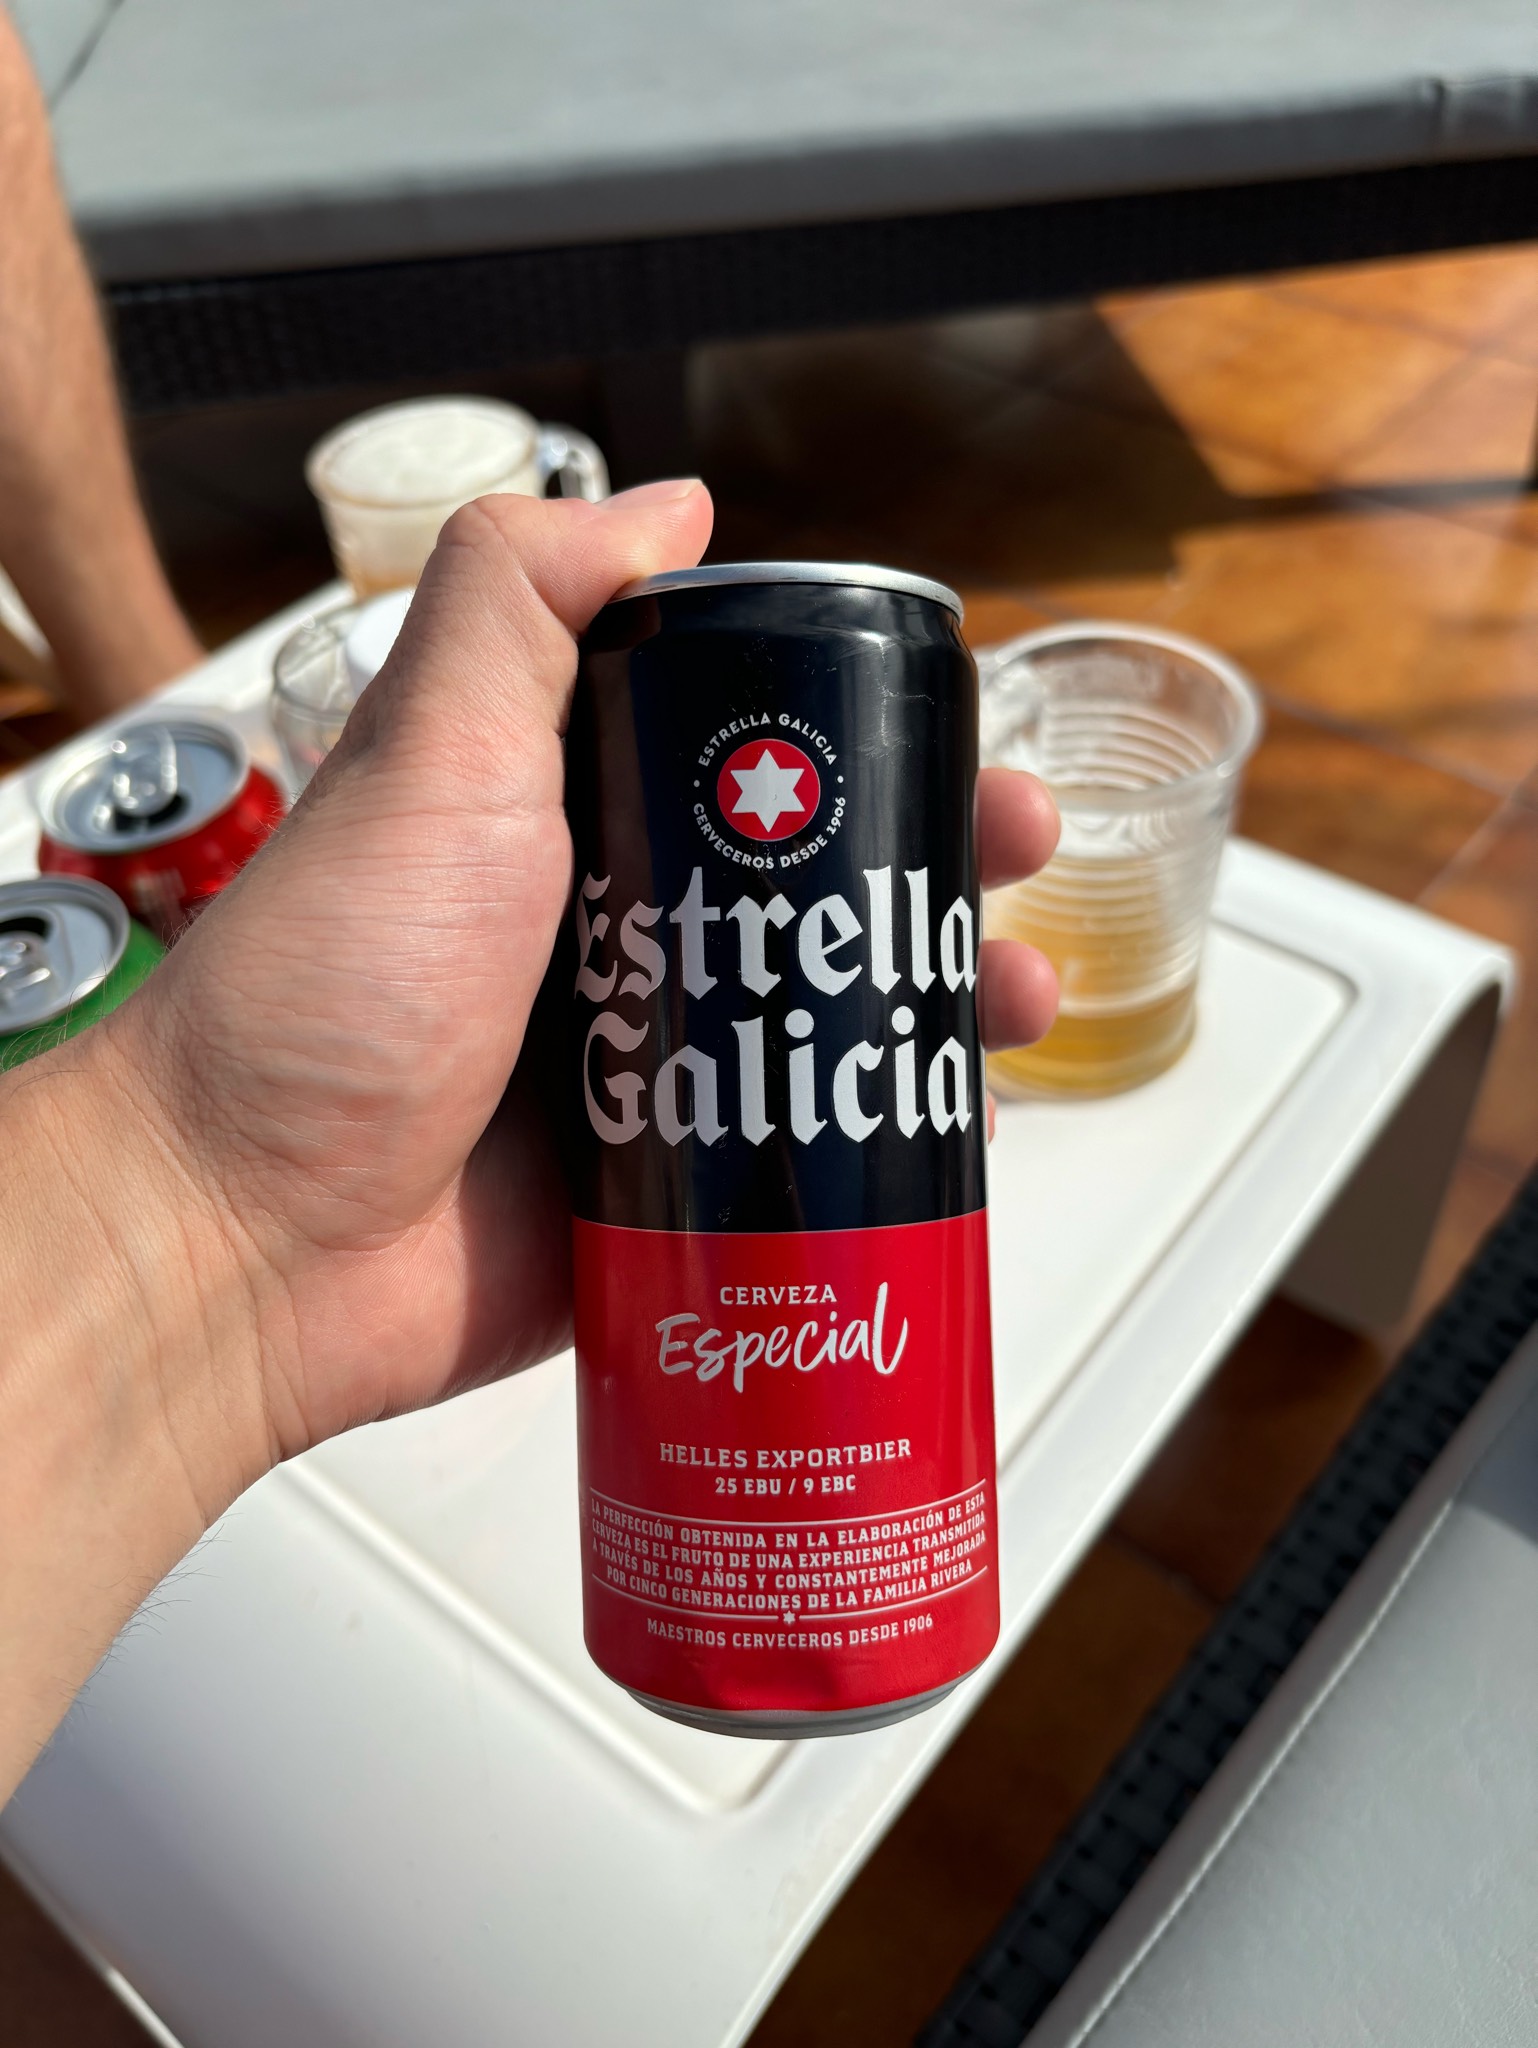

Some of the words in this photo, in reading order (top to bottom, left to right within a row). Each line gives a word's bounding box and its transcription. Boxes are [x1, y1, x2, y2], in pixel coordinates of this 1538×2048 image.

[698, 712, 771, 767] ESTRELLA
[778, 713, 837, 765] GALICIA
[693, 803, 774, 869] CERVECEROS
[780, 834, 828, 868] DESDE
[826, 796, 846, 835] 1906
[575, 864, 976, 1002] Estrella
[583, 1005, 971, 1147] Galicia
[720, 1284, 837, 1305] CERVEZA
[655, 1281, 908, 1393] Especial
[659, 1442, 748, 1468] HELLES
[756, 1438, 911, 1468] EXPORTBIER
[715, 1476, 737, 1494] 25
[744, 1478, 781, 1495] EBU
[788, 1477, 797, 1495] /
[803, 1477, 814, 1494] 9
[820, 1474, 856, 1493] EBC
[591, 1498, 601, 1515] LA
[603, 1505, 674, 1540] PERFECCIÓN
[680, 1527, 767, 1548] OBTENIDA
[775, 1533, 798, 1548] EN
[807, 1532, 829, 1547] LA
[837, 1509, 943, 1545] ELABORACIÓN
[948, 1504, 962, 1522] DE
[965, 1491, 985, 1514] ESTA
[592, 1518, 632, 1549] CERVEZA
[634, 1537, 649, 1555] ES
[652, 1542, 668, 1559] EL
[672, 1546, 724, 1566] FRUTO
[729, 1552, 751, 1568] DE
[756, 1553, 793, 1568] UNA
[799, 1541, 909, 1568] EXPERIENCIA
[913, 1510, 985, 1552] TRANSMITIDA
[592, 1538, 598, 1552] A
[600, 1542, 638, 1571] TRAVÉS
[643, 1559, 660, 1577] DE
[665, 1565, 693, 1584] LOS
[700, 1567, 748, 1588] AÑOS
[755, 1574, 767, 1589] Y
[775, 1556, 928, 1589] CONSTANTEMENTE
[933, 1530, 986, 1567] MEJORADA
[607, 1565, 626, 1586] POR
[629, 1574, 667, 1599] CINCO
[672, 1586, 801, 1609] GENERACIONES
[807, 1593, 830, 1608] DE
[836, 1591, 857, 1606] LA
[863, 1581, 927, 1603] FAMILIA
[931, 1558, 972, 1587] RIVERA
[647, 1618, 726, 1647] MAESTROS
[732, 1632, 843, 1648] CERVECEROS
[848, 1622, 899, 1644] DESDE
[903, 1613, 933, 1635] 1906
